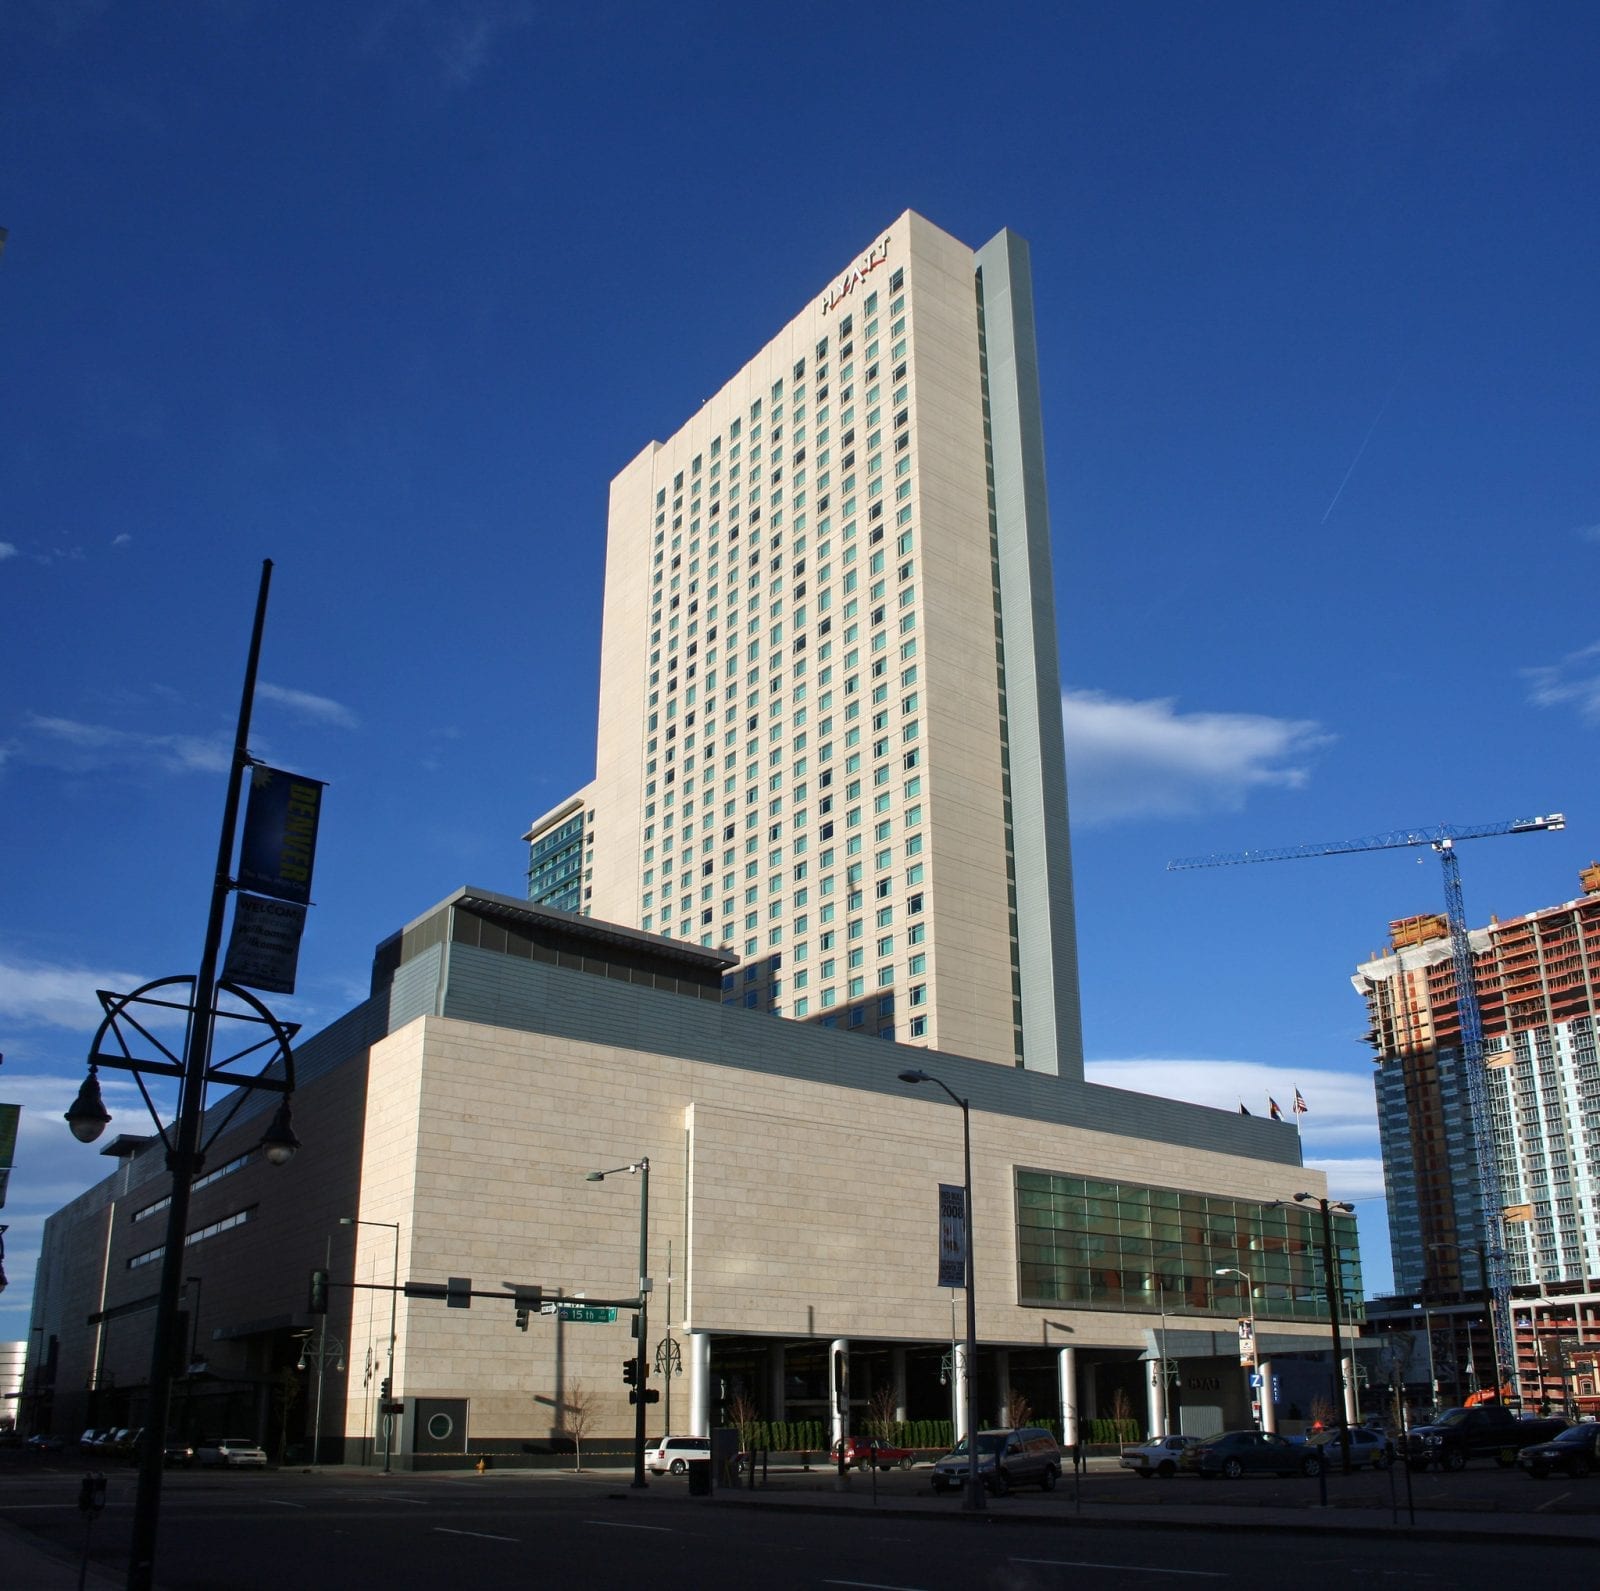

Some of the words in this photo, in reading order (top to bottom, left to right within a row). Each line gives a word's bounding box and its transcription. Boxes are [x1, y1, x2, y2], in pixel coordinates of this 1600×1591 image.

[821, 236, 891, 316] HYATT
[281, 784, 318, 881] DENVER
[240, 898, 303, 921] WELCOME
[941, 1204, 963, 1219] 2008
[572, 1310, 583, 1320] 15
[585, 1310, 594, 1320] th
[1251, 1375, 1260, 1387] Z
